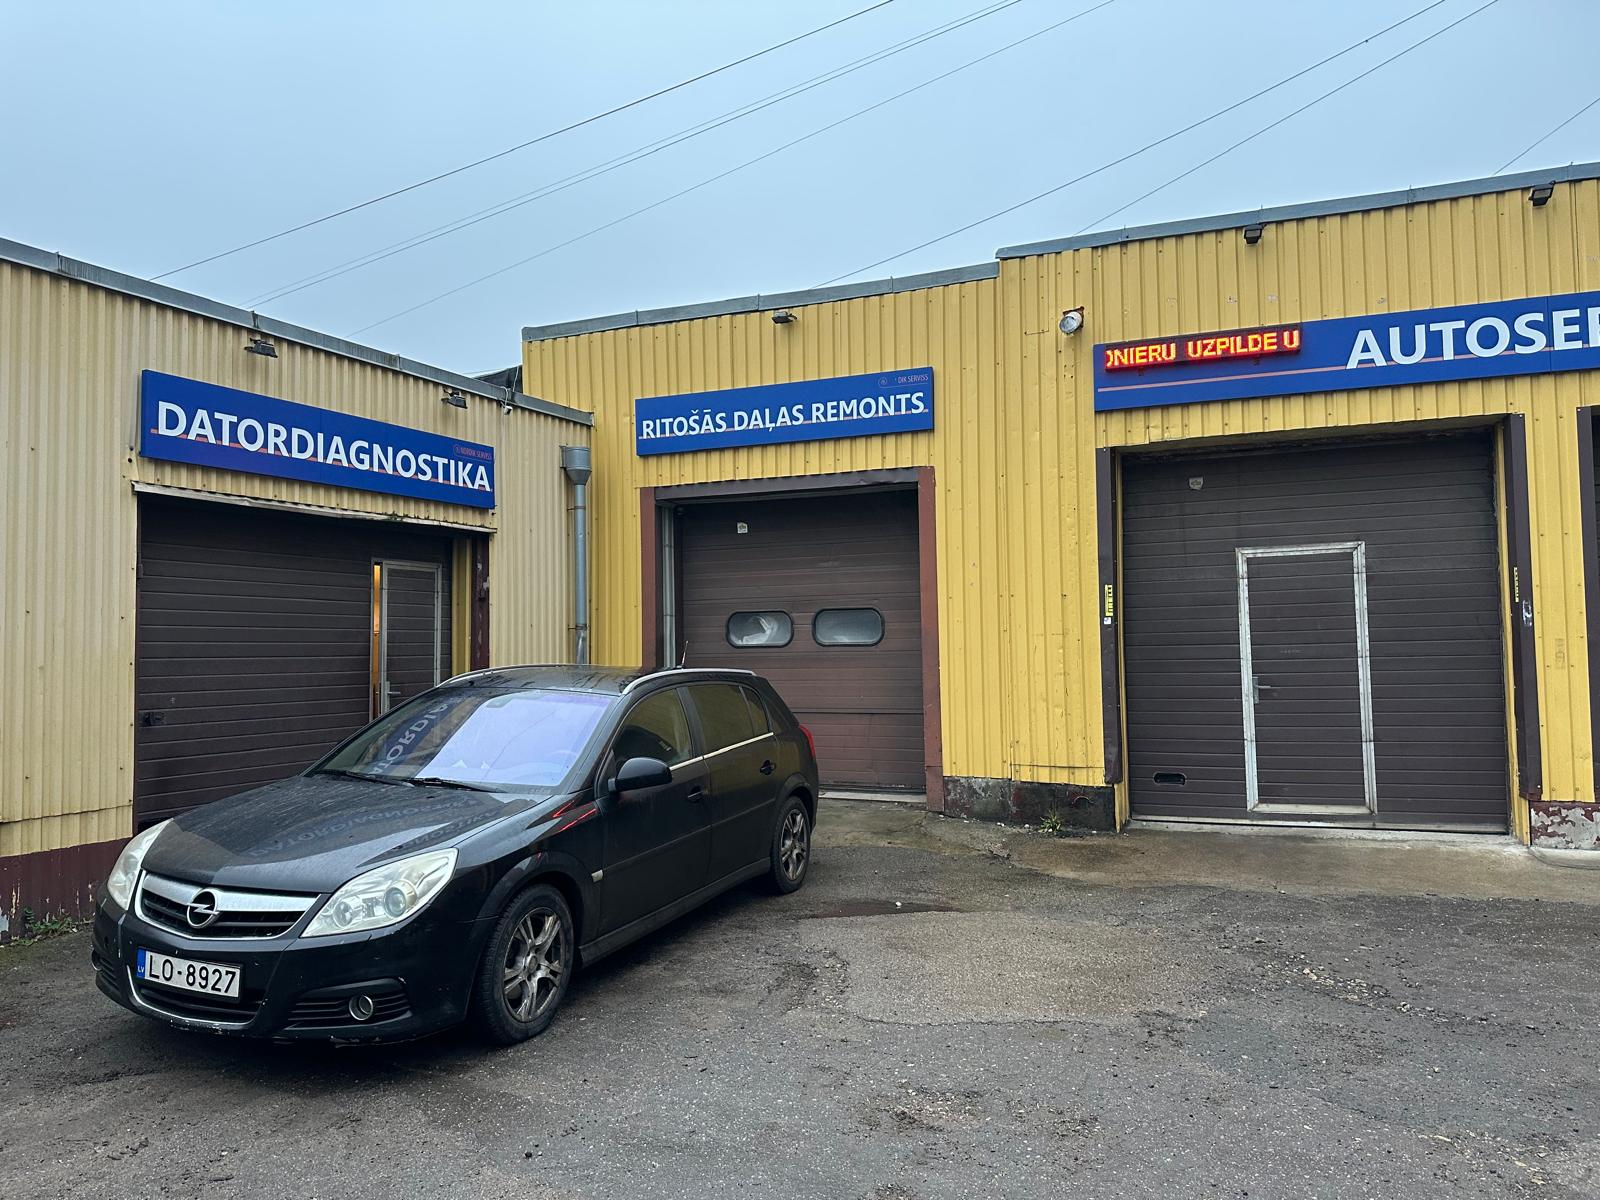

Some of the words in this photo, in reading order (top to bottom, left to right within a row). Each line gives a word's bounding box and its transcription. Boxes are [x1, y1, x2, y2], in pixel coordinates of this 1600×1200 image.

[1187, 332, 1278, 358] UZPILDE
[642, 409, 727, 439] RITOŠĀS
[733, 404, 804, 432] DAĻAS
[811, 392, 925, 424] REMONTS
[158, 400, 491, 492] DATORDIAGNOSTIKA
[137, 965, 145, 973] LV
[149, 954, 236, 993] LO-8927
